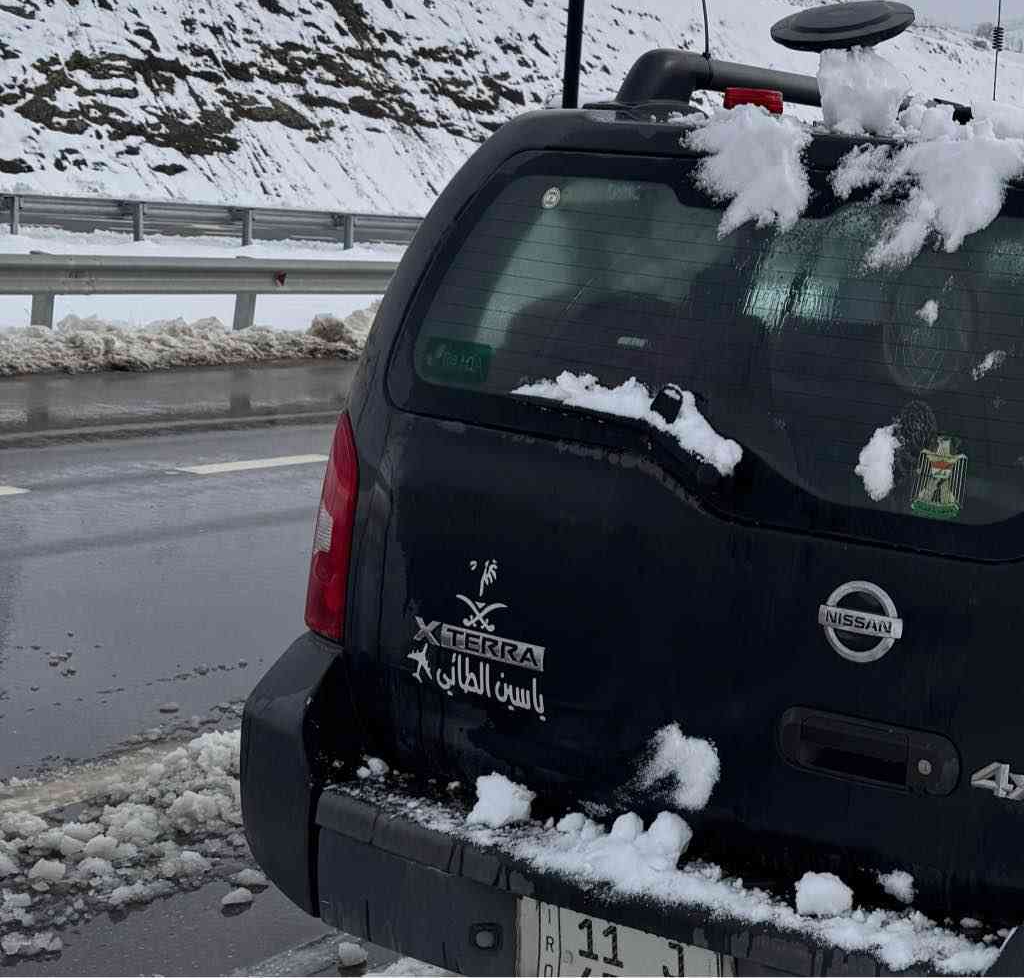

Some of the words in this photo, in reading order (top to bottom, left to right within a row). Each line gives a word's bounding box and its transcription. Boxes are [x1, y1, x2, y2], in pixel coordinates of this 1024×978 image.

[413, 615, 546, 672] XTERRA
[824, 608, 894, 634] NISSAN
[578, 918, 624, 969] 11
